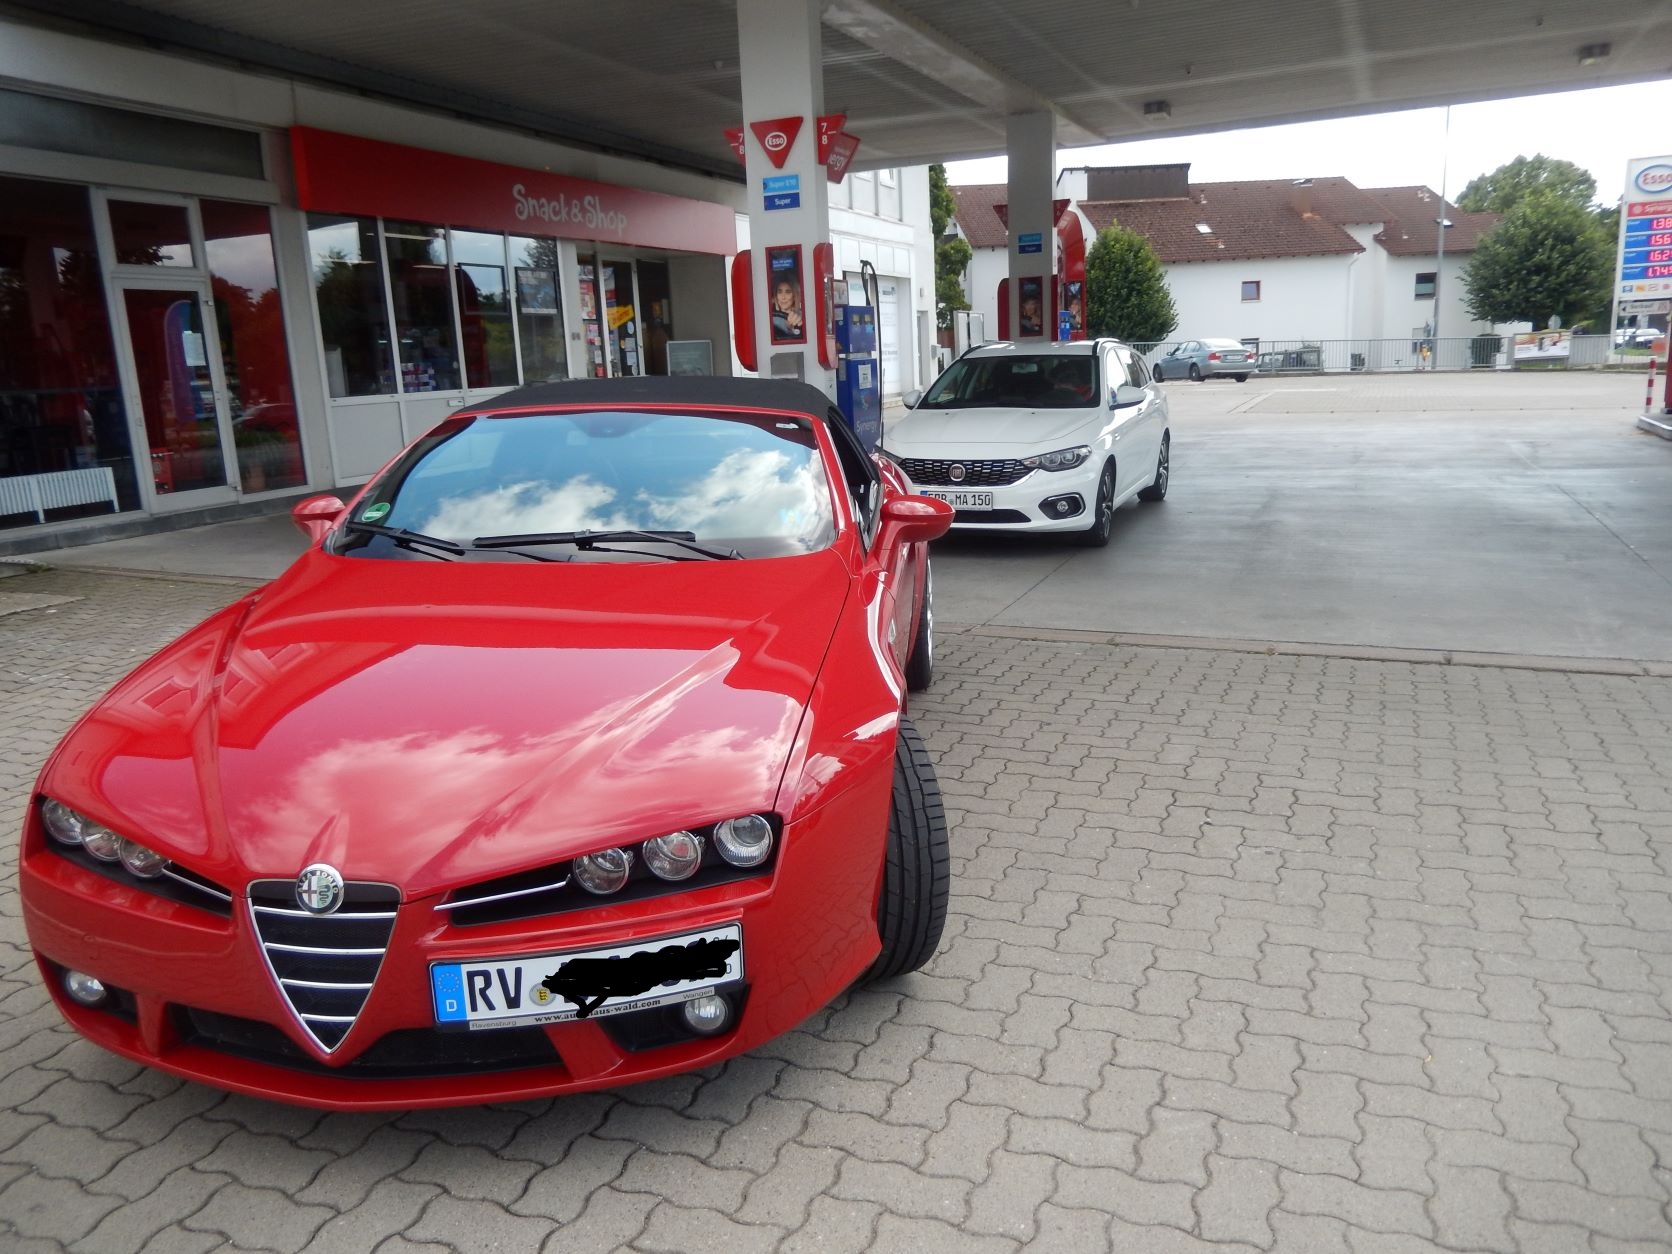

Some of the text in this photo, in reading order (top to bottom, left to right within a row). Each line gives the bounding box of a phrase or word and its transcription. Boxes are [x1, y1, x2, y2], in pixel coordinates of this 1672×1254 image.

[821, 122, 828, 133] 7
[768, 137, 784, 146] Esso
[821, 135, 828, 145] 8
[1642, 173, 1672, 185] Esso
[774, 198, 791, 206] Super
[955, 494, 968, 506] MA
[971, 494, 991, 506] 150
[466, 966, 523, 1013] RV
[683, 988, 713, 1000] Wangen
[445, 999, 458, 1012] D
[534, 999, 661, 1023] www.auaus-wald.com
